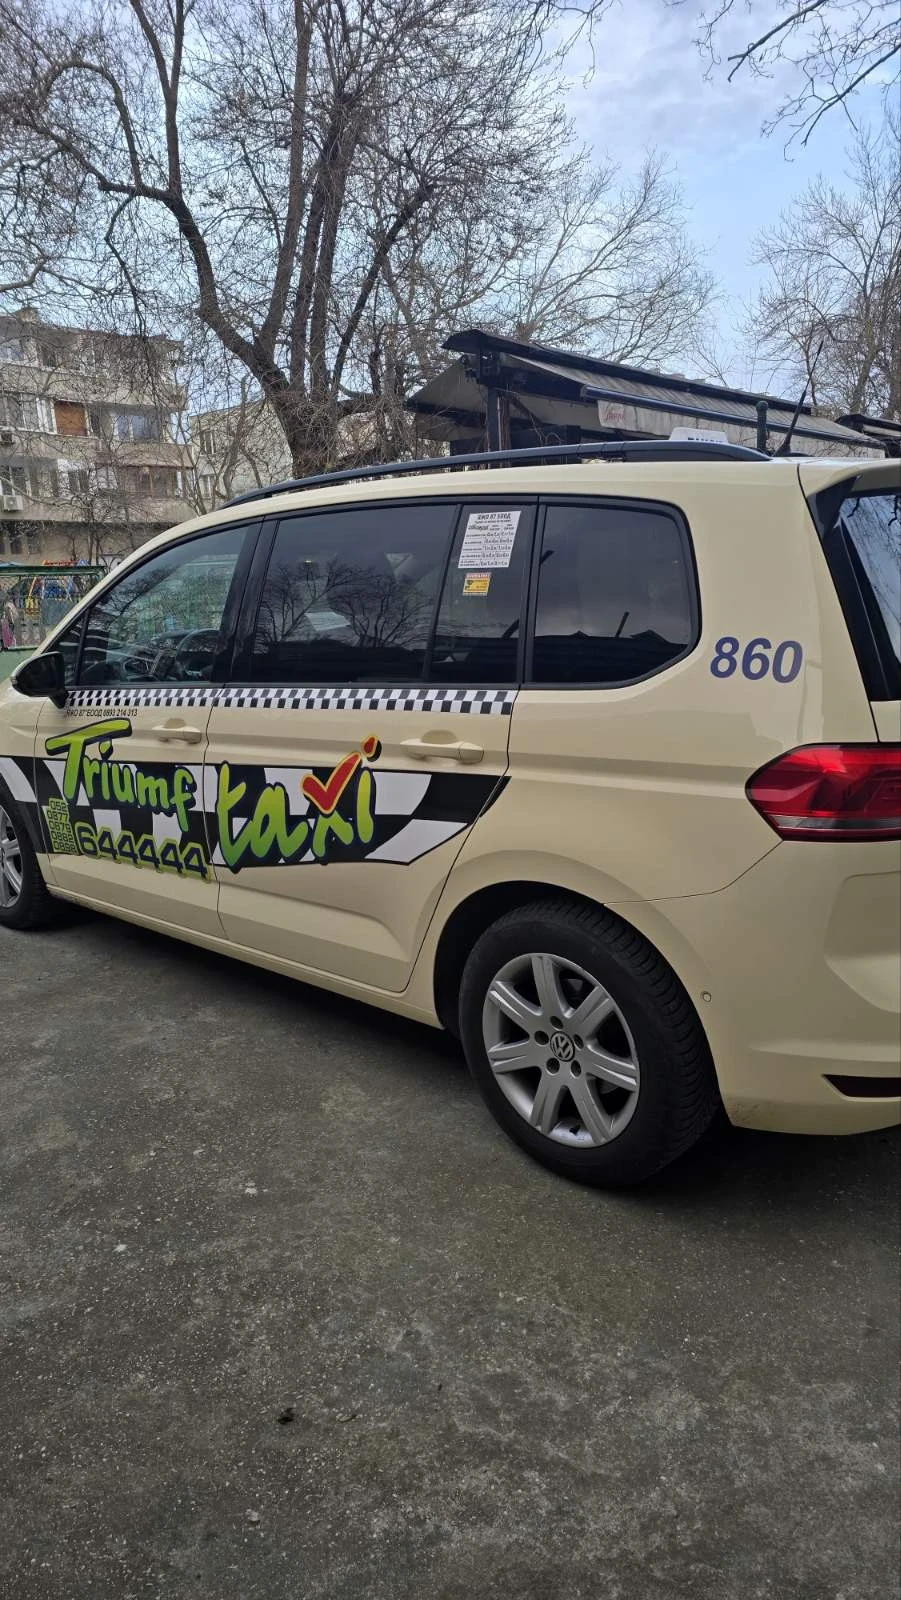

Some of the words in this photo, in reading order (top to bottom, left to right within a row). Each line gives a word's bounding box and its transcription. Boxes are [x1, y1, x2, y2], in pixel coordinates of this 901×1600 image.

[710, 636, 803, 684] 860
[117, 708, 127, 717] 214
[128, 708, 138, 717] 313
[44, 717, 197, 833] Triumf
[50, 800, 68, 812] 052
[215, 736, 382, 874] taxi
[46, 810, 68, 822] 0877
[48, 820, 71, 834] 0879
[51, 830, 74, 845] 0882
[75, 822, 212, 884] 644444
